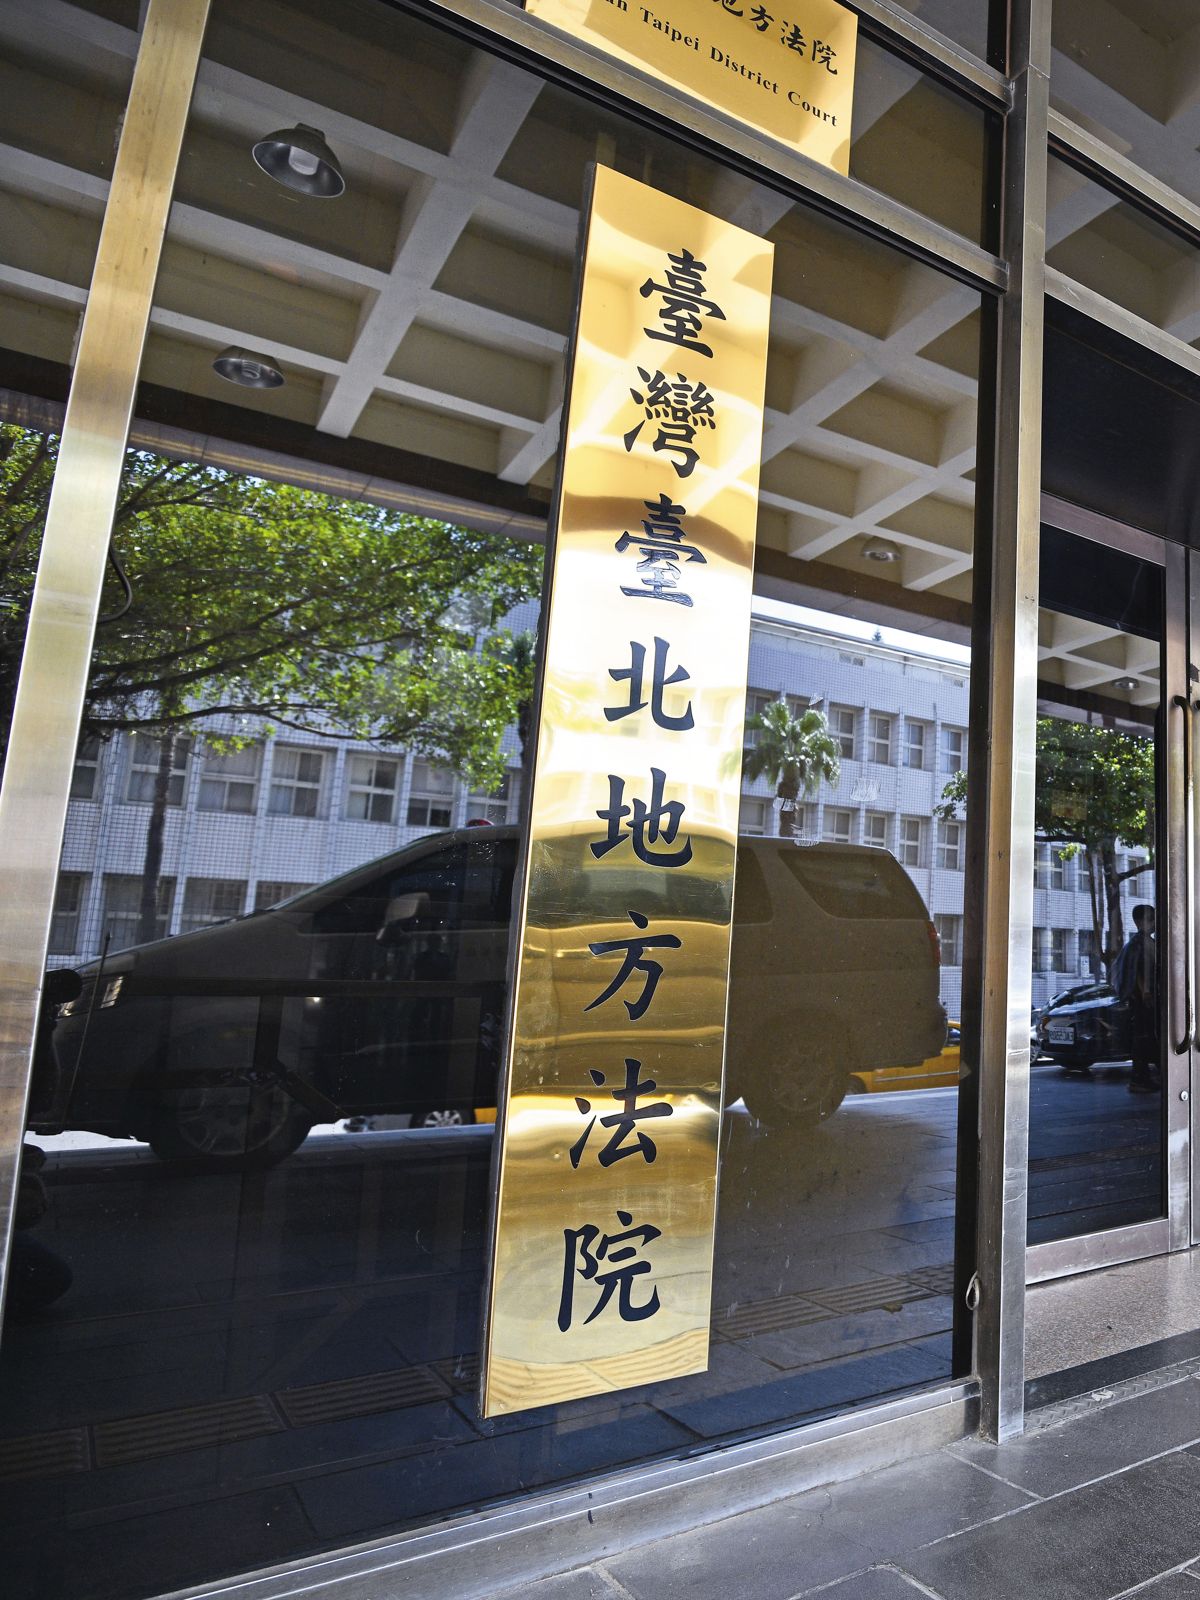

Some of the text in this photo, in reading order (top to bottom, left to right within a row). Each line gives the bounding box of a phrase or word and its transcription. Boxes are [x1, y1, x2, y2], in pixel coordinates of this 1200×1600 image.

[639, 7, 699, 51] Taipei
[710, 46, 778, 94] District
[787, 91, 837, 127] Court
[557, 248, 727, 1333] 臺灣臺北地方法院
